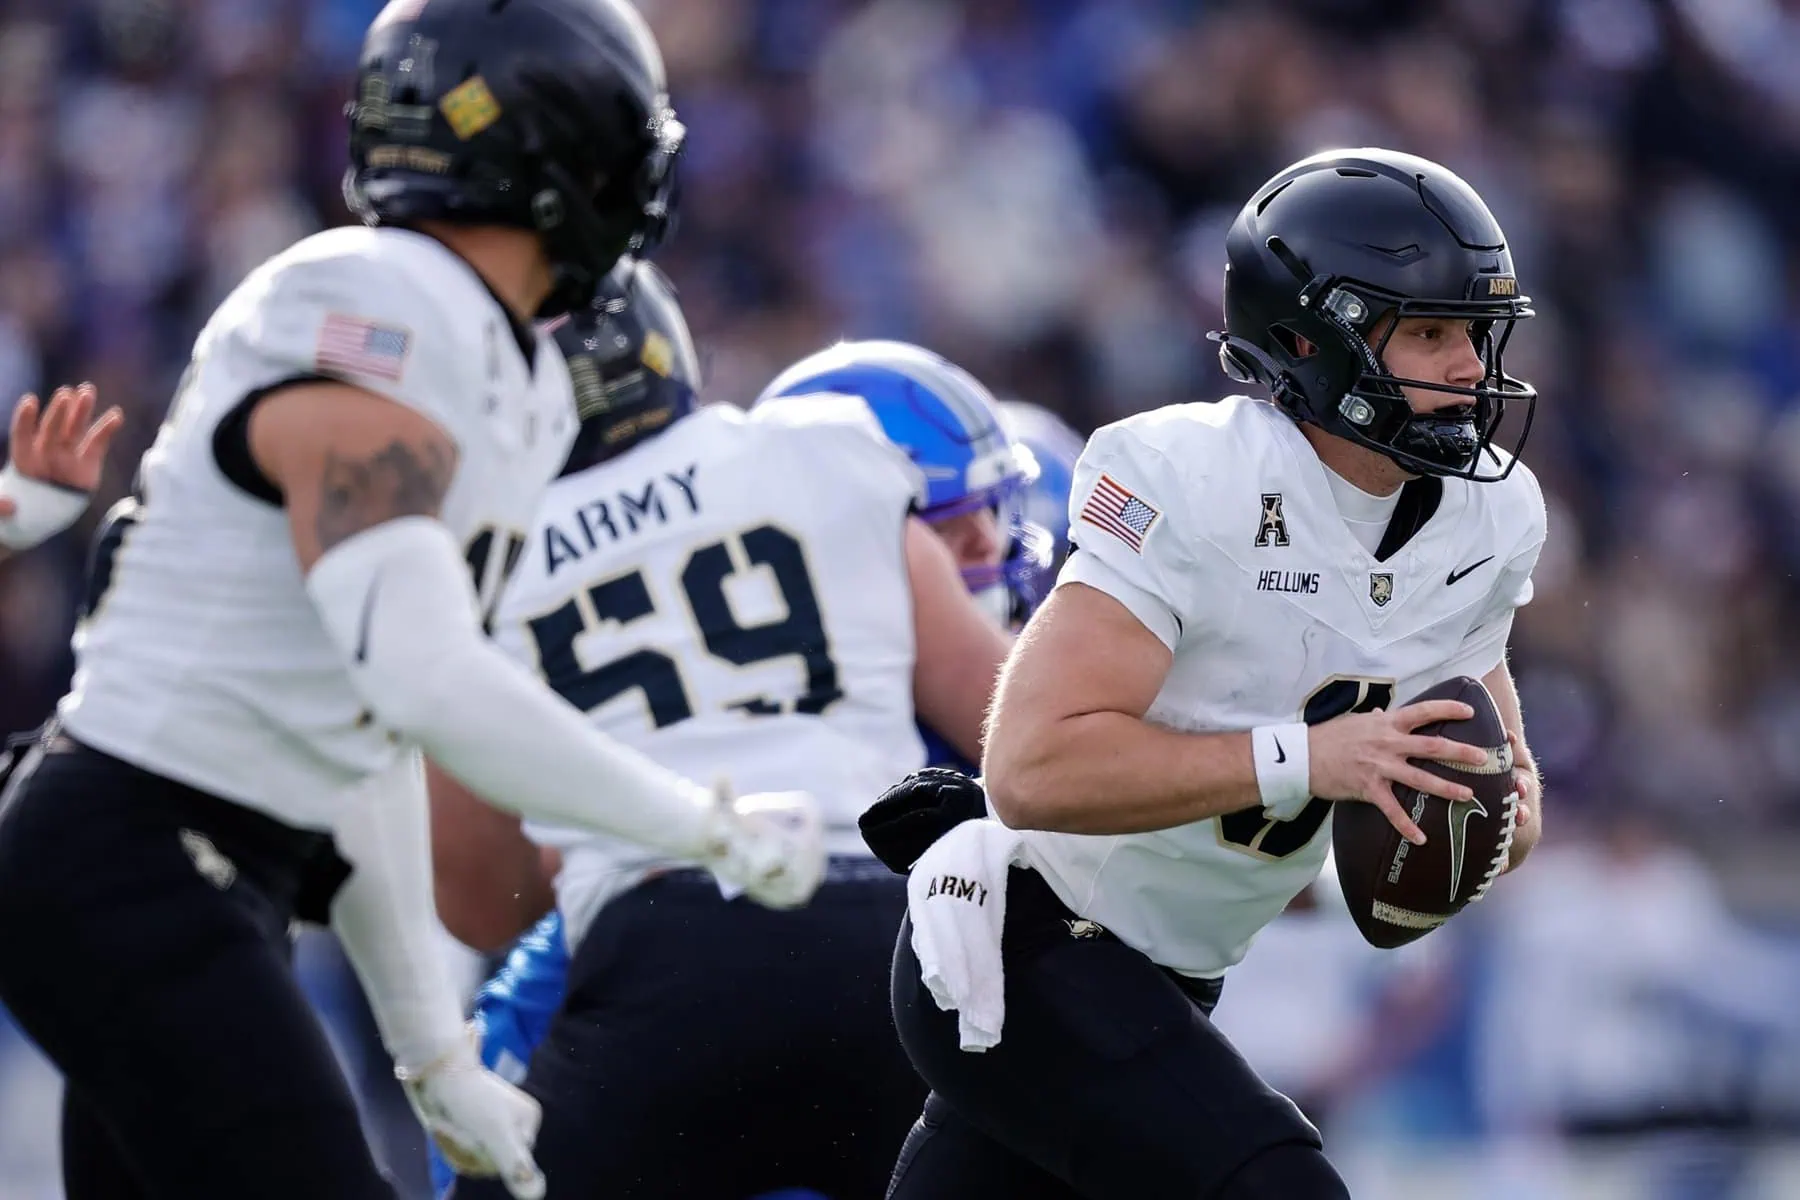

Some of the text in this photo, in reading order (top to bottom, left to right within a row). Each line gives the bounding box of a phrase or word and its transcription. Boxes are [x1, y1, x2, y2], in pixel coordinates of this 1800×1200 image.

[1488, 278, 1516, 295] ARMY
[544, 464, 700, 577] ARMY
[1255, 493, 1290, 547] A
[1257, 570, 1320, 594] HELLUMS
[524, 522, 848, 730] 59
[926, 875, 988, 907] ARMY
